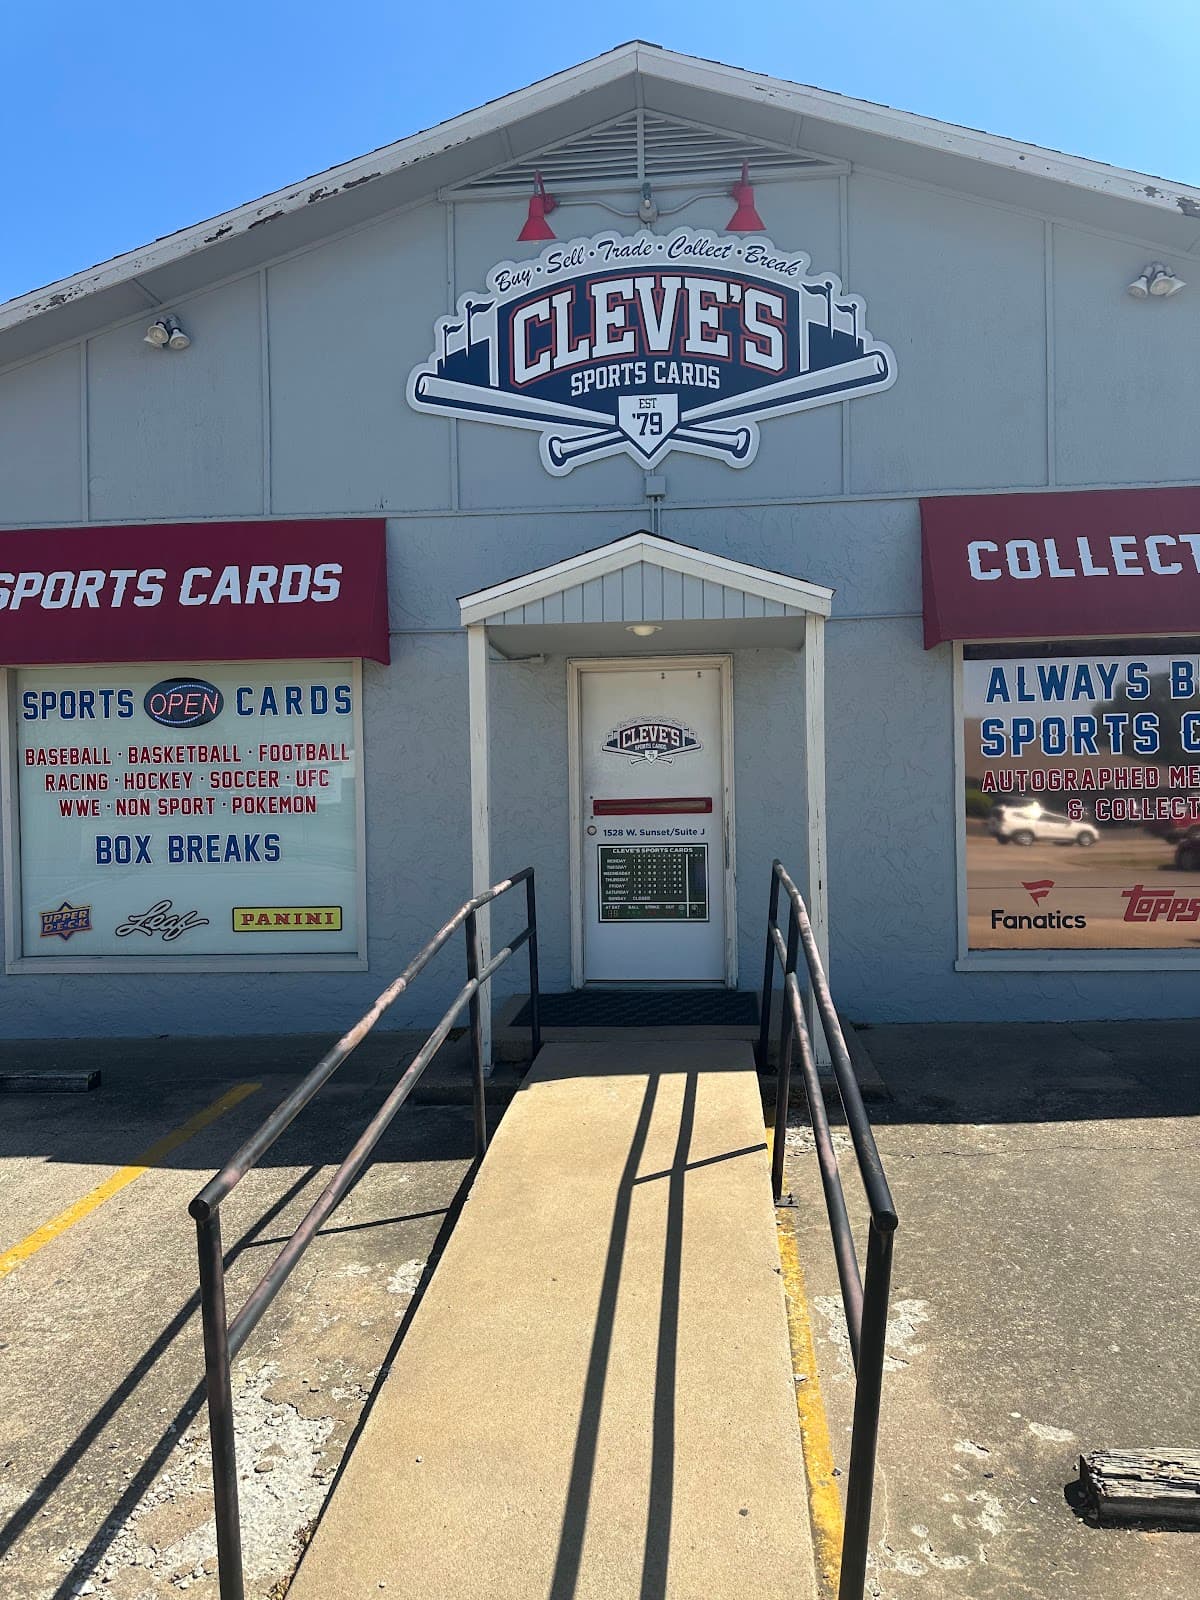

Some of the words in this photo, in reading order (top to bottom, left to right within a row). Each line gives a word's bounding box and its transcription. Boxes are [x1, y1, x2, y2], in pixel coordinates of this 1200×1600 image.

[495, 269, 532, 293] Buy
[546, 247, 585, 275] Sell
[597, 240, 653, 261] Trade
[667, 236, 733, 259] Collect
[744, 246, 801, 276] Break
[510, 273, 787, 387] CLEVE'S
[570, 361, 647, 397] SPORTS
[654, 360, 721, 389] CARDS
[638, 398, 658, 411] EST
[631, 412, 664, 437] '79
[178, 563, 344, 607] CARDS
[984, 662, 1150, 704] ALWAYS
[23, 688, 135, 721] SPORTS
[235, 684, 353, 717] CARDS
[150, 692, 219, 716] OPEN
[622, 725, 680, 748] CLEVE'S
[980, 712, 1160, 758] SPORTS
[25, 747, 112, 767] BASEBALL
[128, 744, 242, 765] BASKETBALL
[258, 743, 351, 763] FOOTBALL
[44, 773, 109, 793] RACING
[123, 771, 194, 791] HOCKEY
[209, 770, 280, 789] SOCCER
[296, 768, 330, 788] UFC
[981, 766, 1161, 793] AUTOGRAPHED
[59, 798, 101, 817] WWE
[115, 797, 151, 817] NON
[157, 797, 216, 816] SPORT
[231, 795, 317, 815] POKEMON
[1067, 798, 1085, 822] &
[603, 829, 624, 837] 1528
[626, 829, 638, 837] W.
[639, 827, 698, 837] Sunset/Suite
[700, 828, 705, 836] J
[95, 833, 152, 866] BOX
[167, 832, 282, 864] BREAKS
[43, 910, 89, 924] UPPER
[115, 899, 210, 941] Leaf
[239, 912, 336, 928] PANINI
[991, 909, 1087, 930] Fanatics
